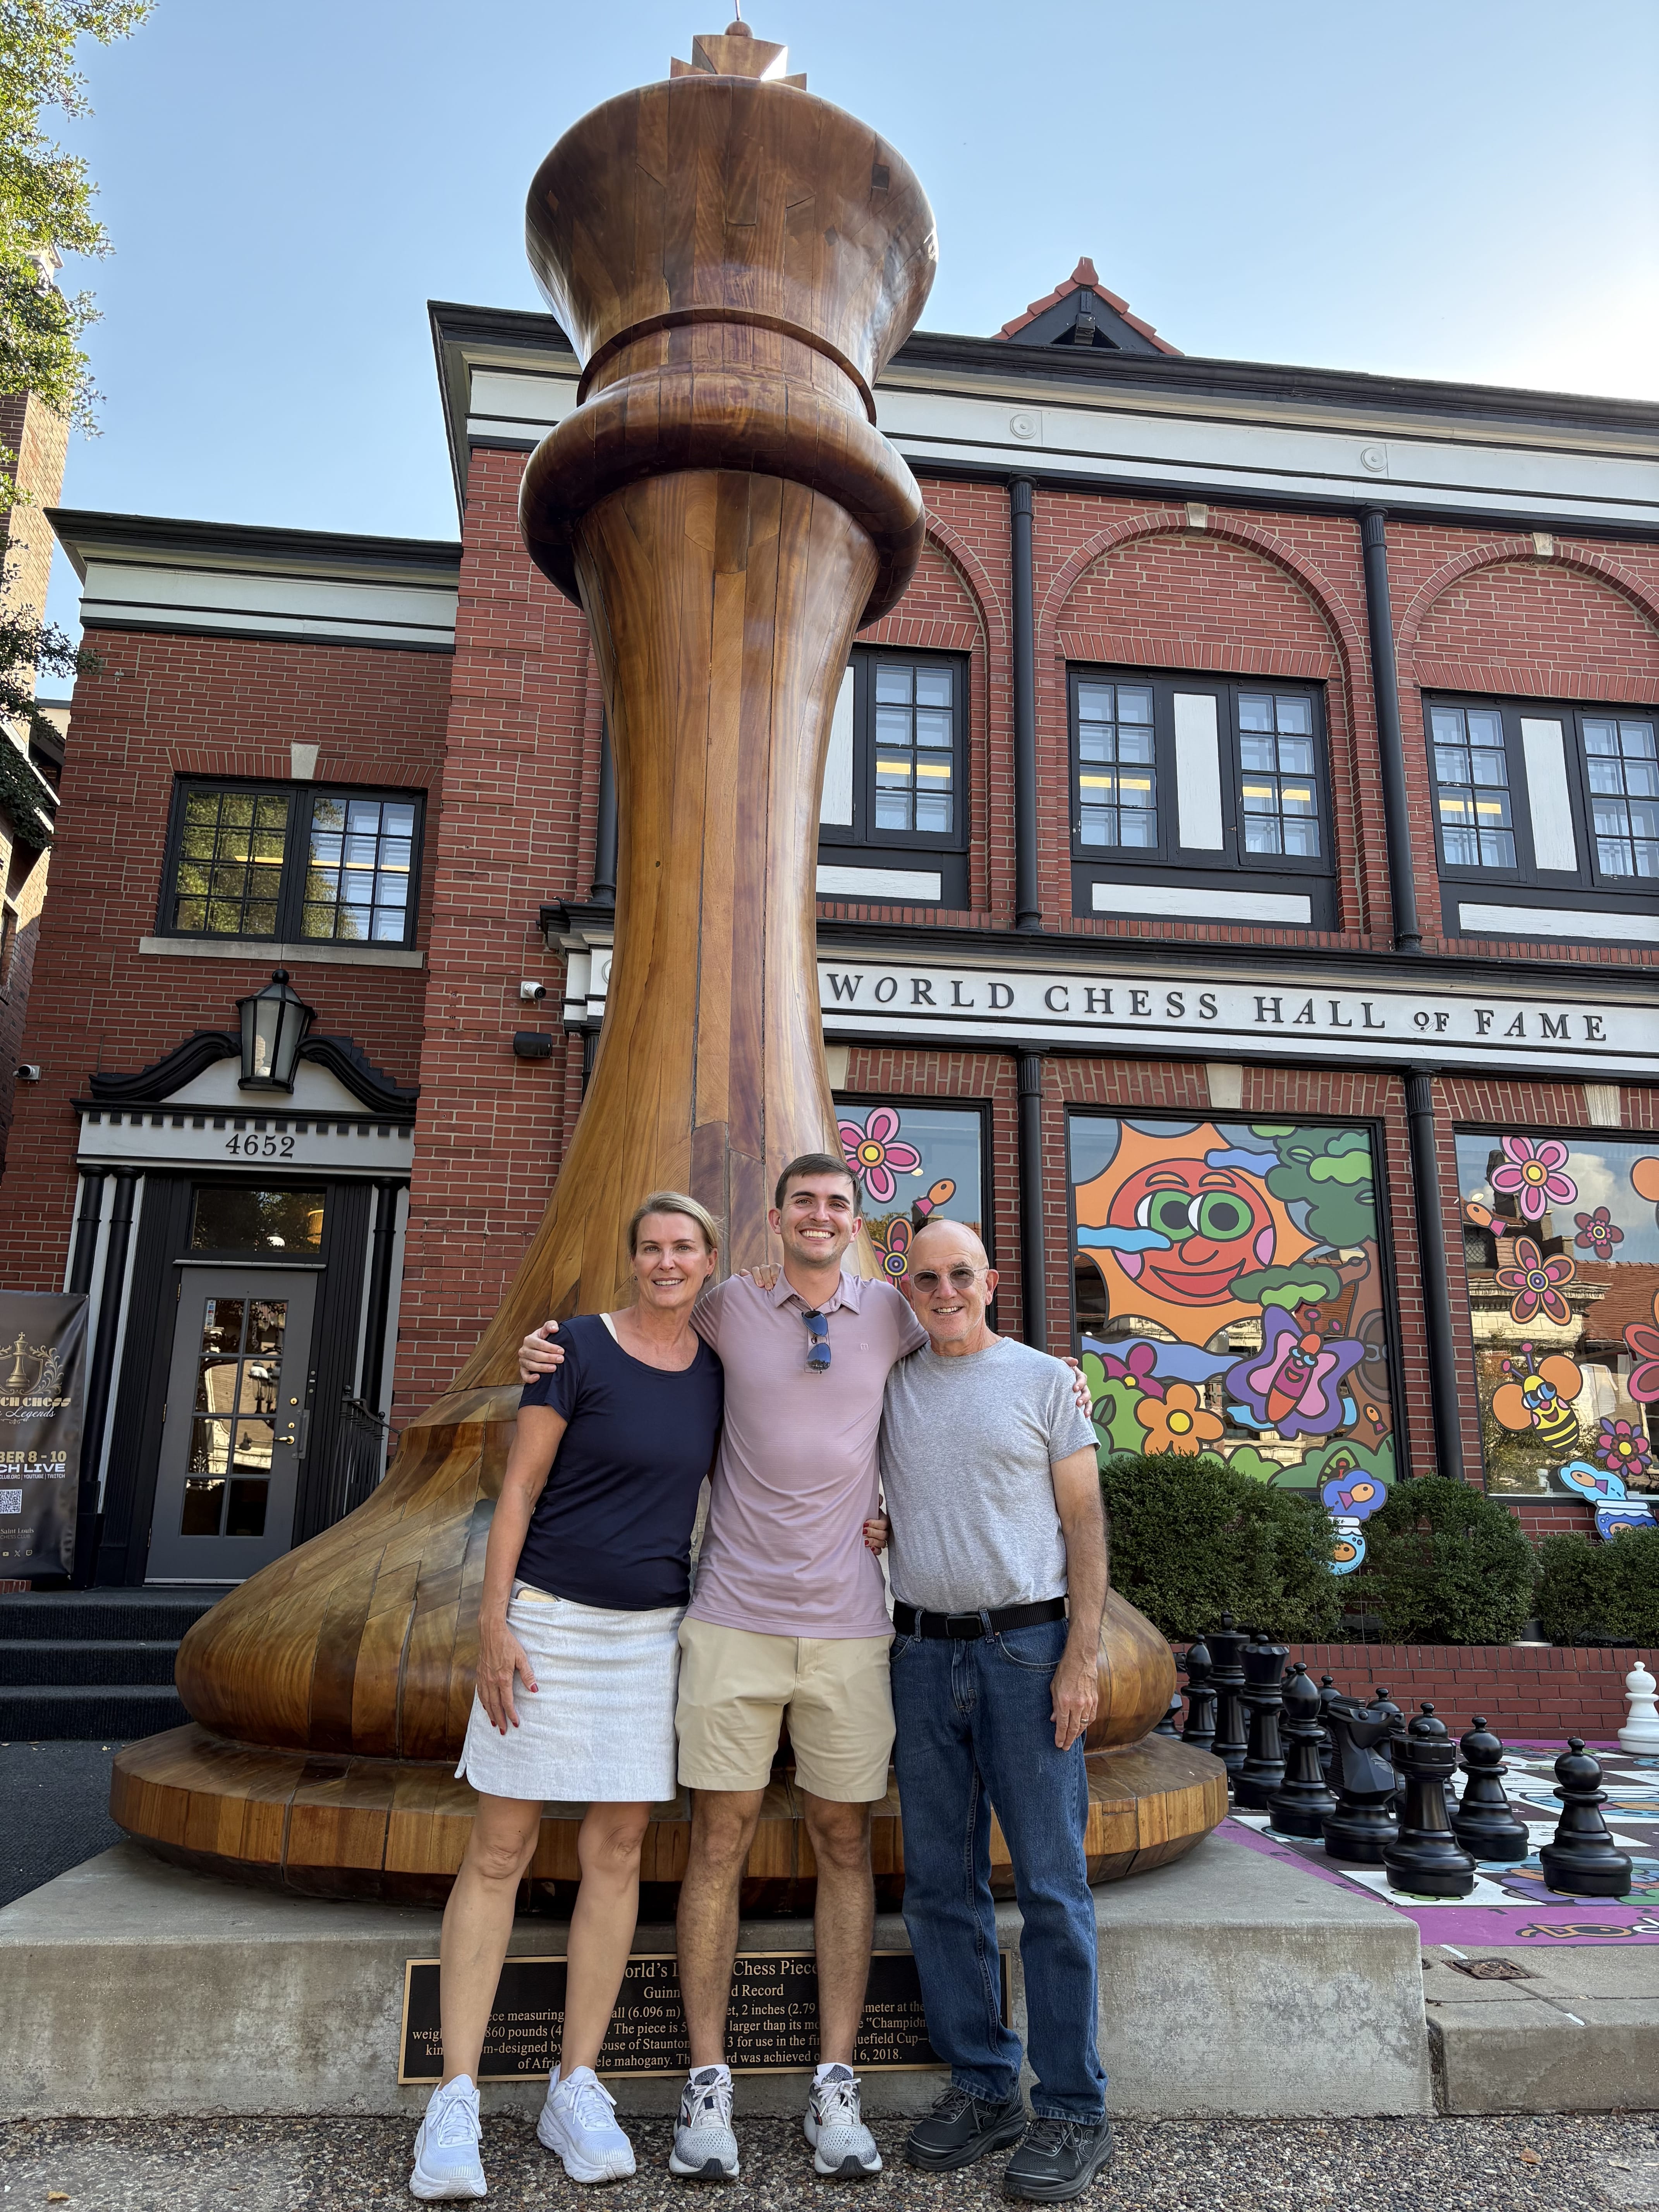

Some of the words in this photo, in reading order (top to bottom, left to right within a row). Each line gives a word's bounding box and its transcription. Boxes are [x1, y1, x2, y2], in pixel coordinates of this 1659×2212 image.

[826, 973, 1015, 1009] WORLD
[1044, 985, 1218, 1020] CHESS
[1254, 996, 1386, 1029] HALL
[1414, 1012, 1449, 1032] OF
[1474, 1008, 1607, 1042] FAME
[225, 1133, 295, 1159] 4652
[5, 1406, 56, 1422] Legends
[28, 1451, 38, 1463] 8
[50, 1451, 67, 1462] 10
[24, 1463, 65, 1473] LIVE
[625, 1962, 668, 1978] orld’s
[733, 1961, 775, 1975] Chess
[644, 1986, 680, 1999] Guinn
[742, 1984, 784, 1996] Record
[508, 2009, 564, 2022] measuring
[611, 2007, 625, 2018] all
[629, 2006, 663, 2020] (6.096
[666, 2006, 680, 2019] m)
[742, 2004, 748, 2015] 2
[752, 2004, 785, 2015] inches
[788, 2003, 816, 2017] (2.79
[866, 2003, 895, 2012] meter
[485, 2026, 505, 2038] 860
[508, 2025, 548, 2040] pounds
[614, 2023, 635, 2034] The
[638, 2022, 666, 2036] piece
[670, 2022, 678, 2033] is
[729, 2020, 761, 2033] larger
[763, 2020, 786, 2031] than
[789, 2019, 802, 2030] its
[426, 2044, 443, 2055] kin
[601, 2040, 625, 2051] ouse
[629, 2039, 641, 2049] of
[737, 2036, 752, 2047] for
[756, 2037, 773, 2046] use
[776, 2035, 786, 2046] in
[790, 2035, 805, 2045] the
[855, 2033, 894, 2046] uefield
[518, 2058, 531, 2069] of
[614, 2055, 672, 2068] mahogany.
[676, 2054, 690, 2064] Th
[740, 2054, 761, 2063] was
[764, 2051, 811, 2063] achieved
[860, 2049, 869, 2061] 6,
[873, 2049, 902, 2060] 2018.
